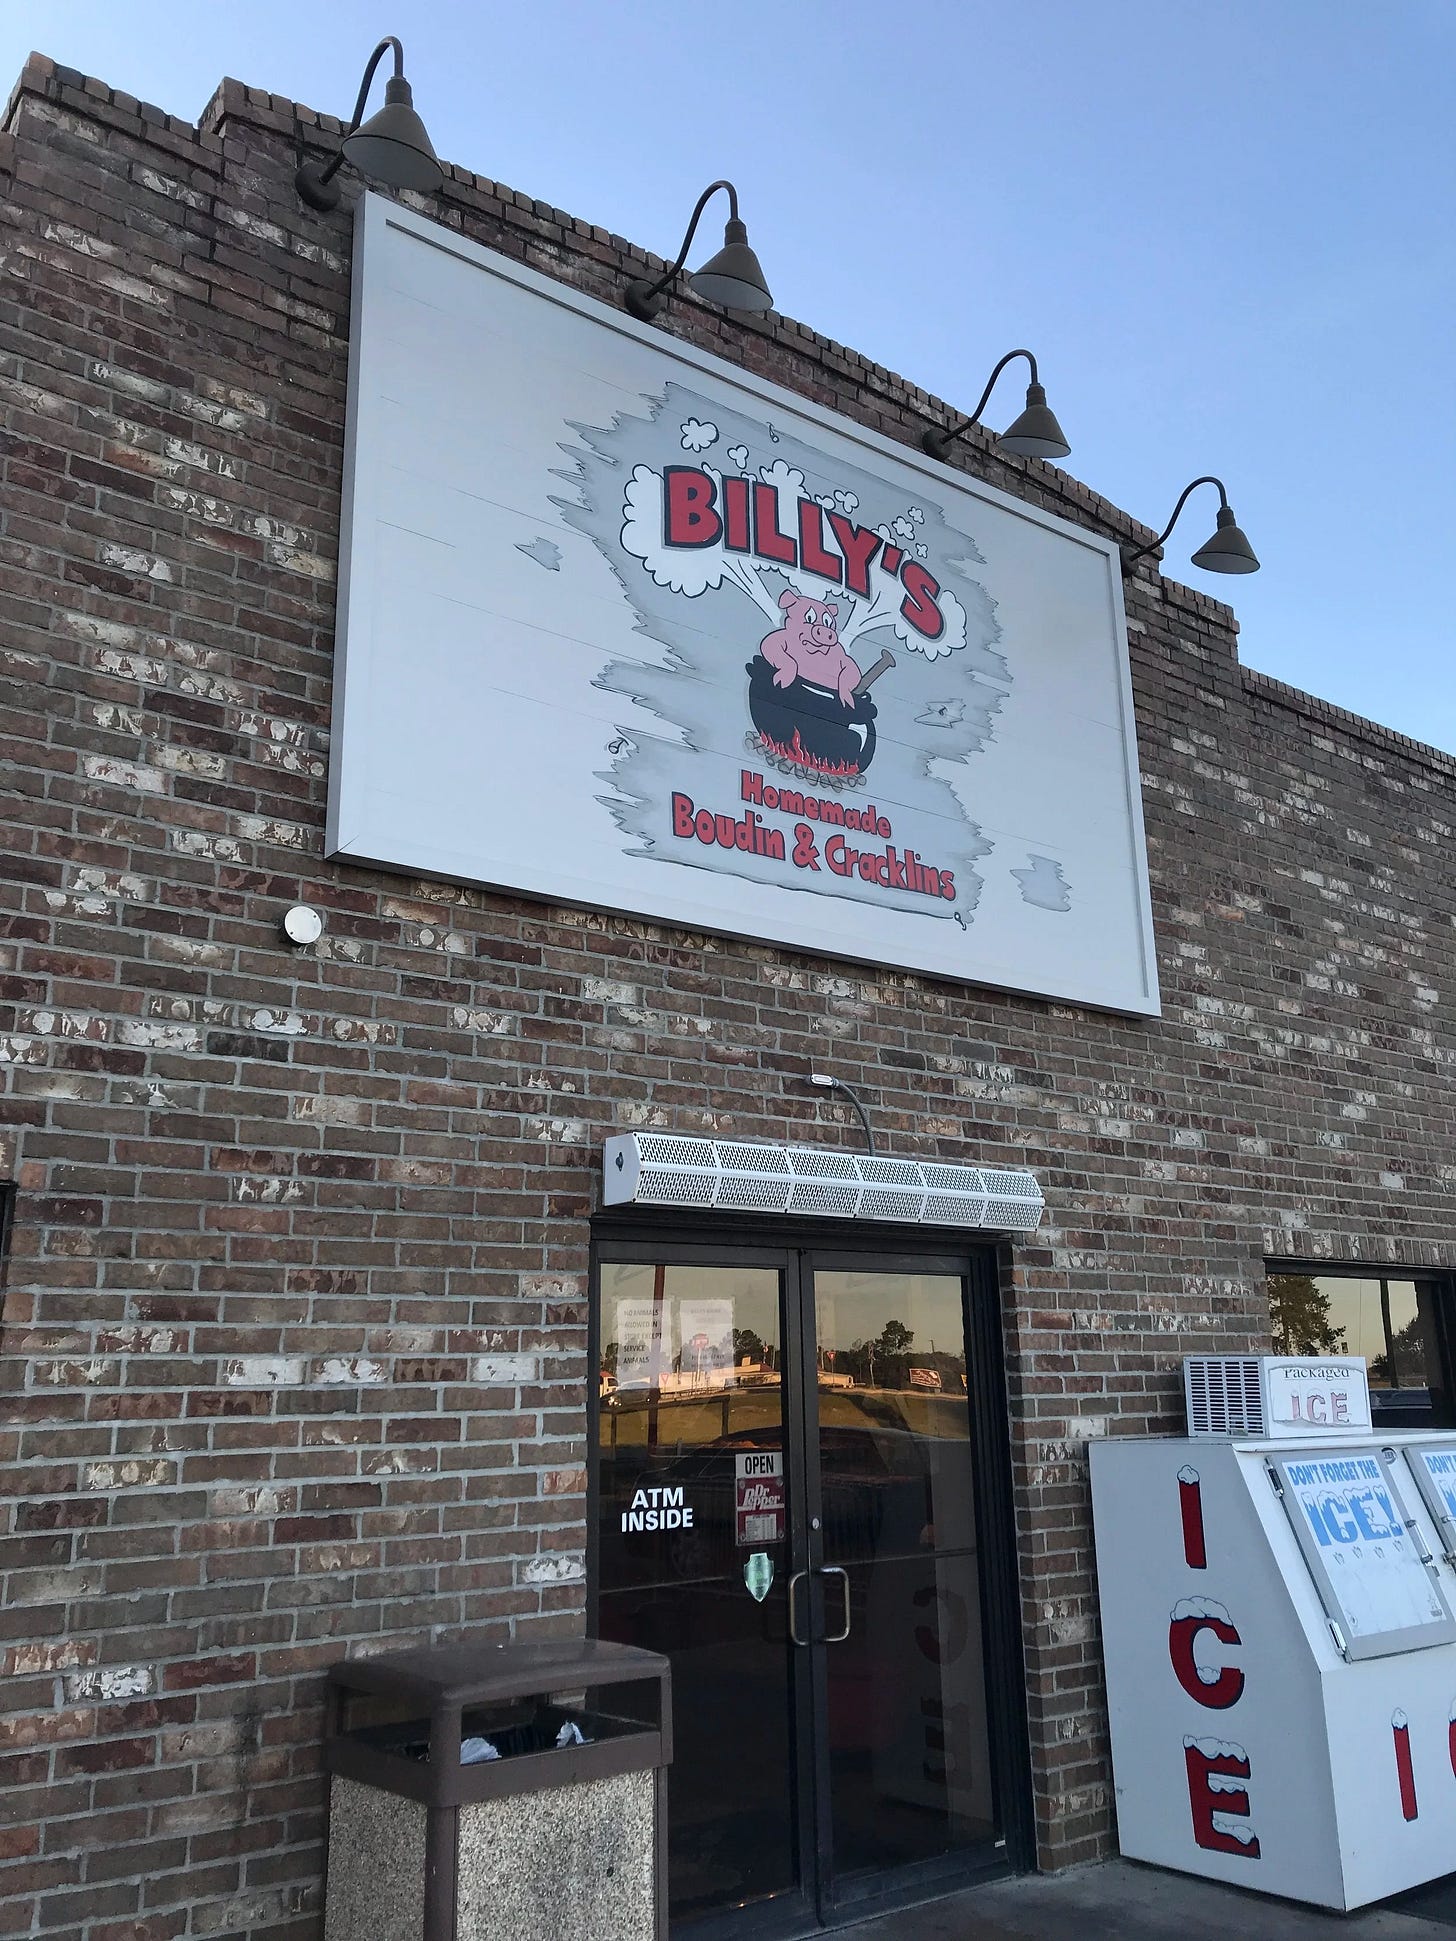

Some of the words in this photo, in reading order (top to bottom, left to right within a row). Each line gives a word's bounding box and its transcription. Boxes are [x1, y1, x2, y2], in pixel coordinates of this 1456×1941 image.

[663, 465, 944, 640] BILLY'S
[740, 769, 891, 839] Homemade
[671, 791, 785, 860] Boudin
[792, 823, 821, 871] &
[825, 834, 956, 901] Cracklins
[1290, 1390, 1350, 1424] ICE
[744, 1454, 774, 1475] OPEN
[1287, 1465, 1324, 1486] DON'T
[1320, 1461, 1356, 1482] FORGET
[1359, 1459, 1380, 1479] THE
[631, 1486, 684, 1509] ATM
[743, 1488, 781, 1511] Pepper
[755, 1484, 770, 1497] Dr
[621, 1507, 693, 1532] INSIDE
[1300, 1484, 1404, 1547] ICE!
[1168, 1464, 1261, 1859] ICE
